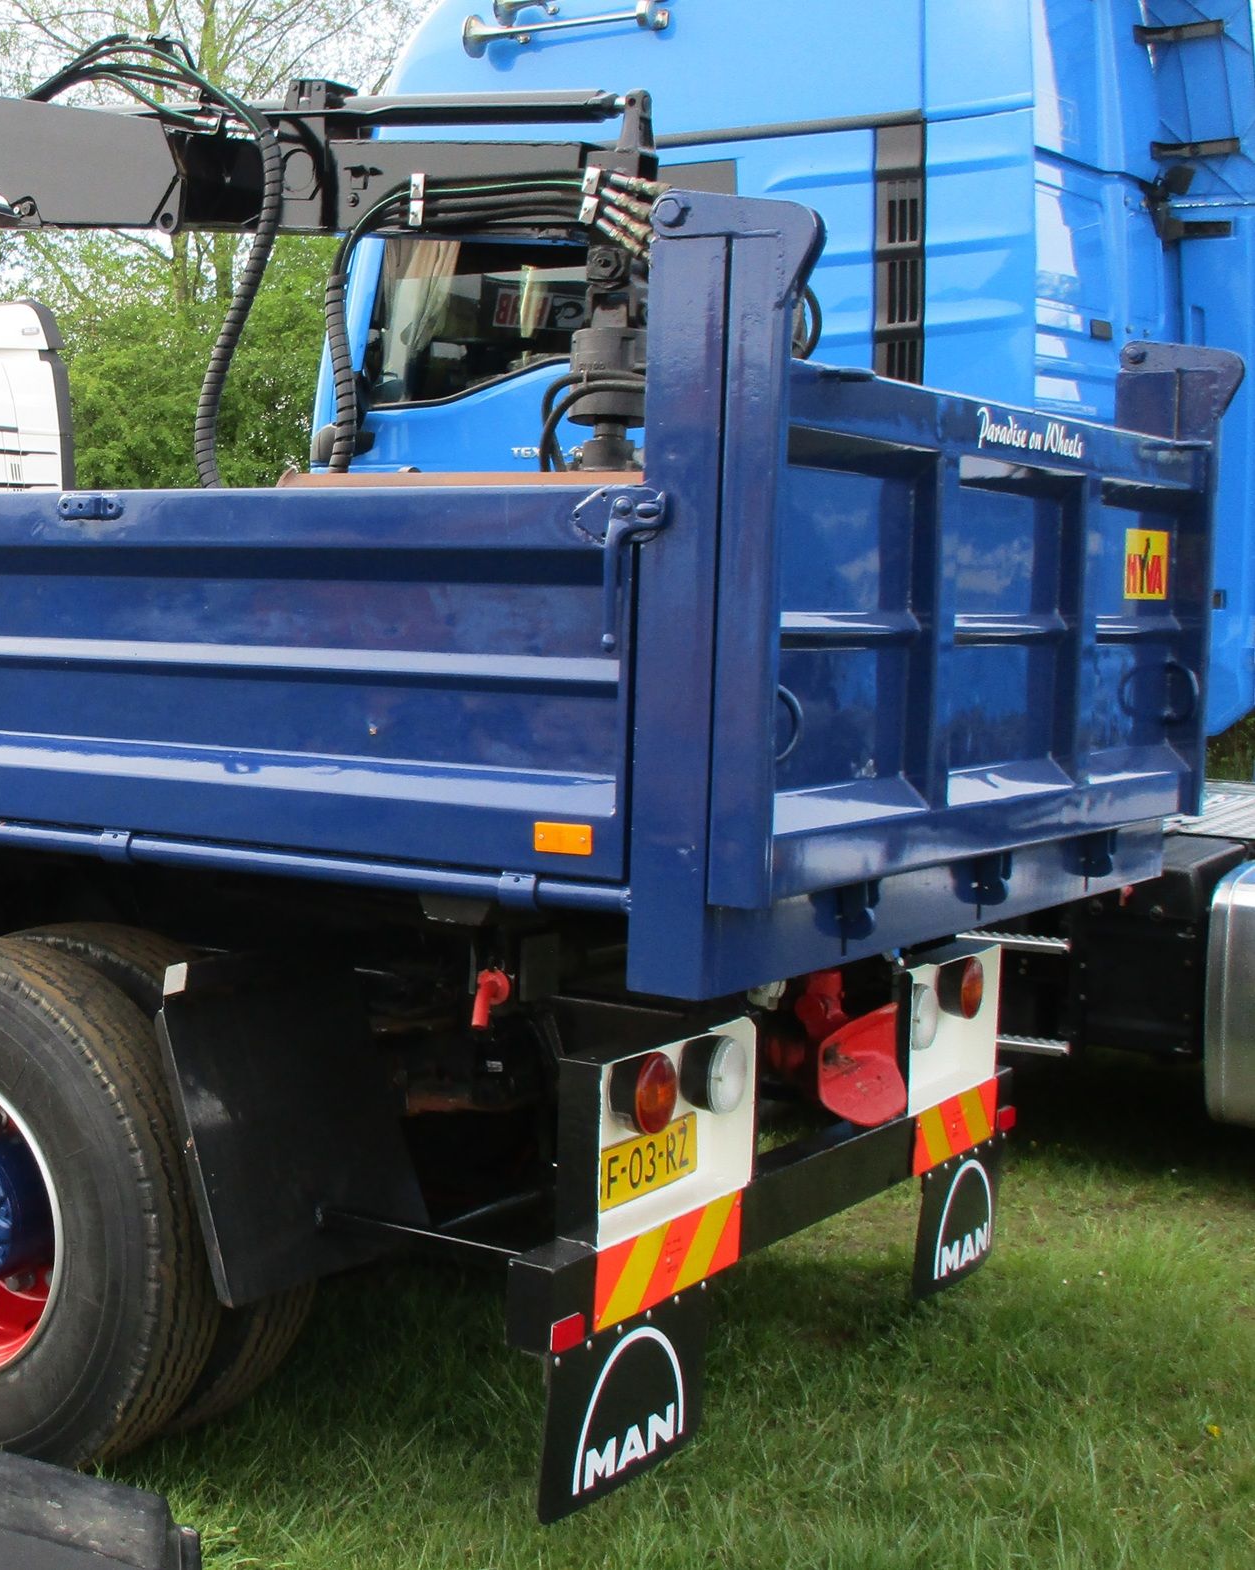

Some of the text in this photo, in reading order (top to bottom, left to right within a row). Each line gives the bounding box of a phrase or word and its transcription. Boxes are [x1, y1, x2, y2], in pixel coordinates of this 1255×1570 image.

[977, 407, 1083, 459] Paradise on Wheels
[1127, 538, 1163, 593] HYVA
[600, 1124, 690, 1200] F-03-RZ
[941, 1222, 990, 1278] MAN
[583, 1403, 677, 1490] MAN
